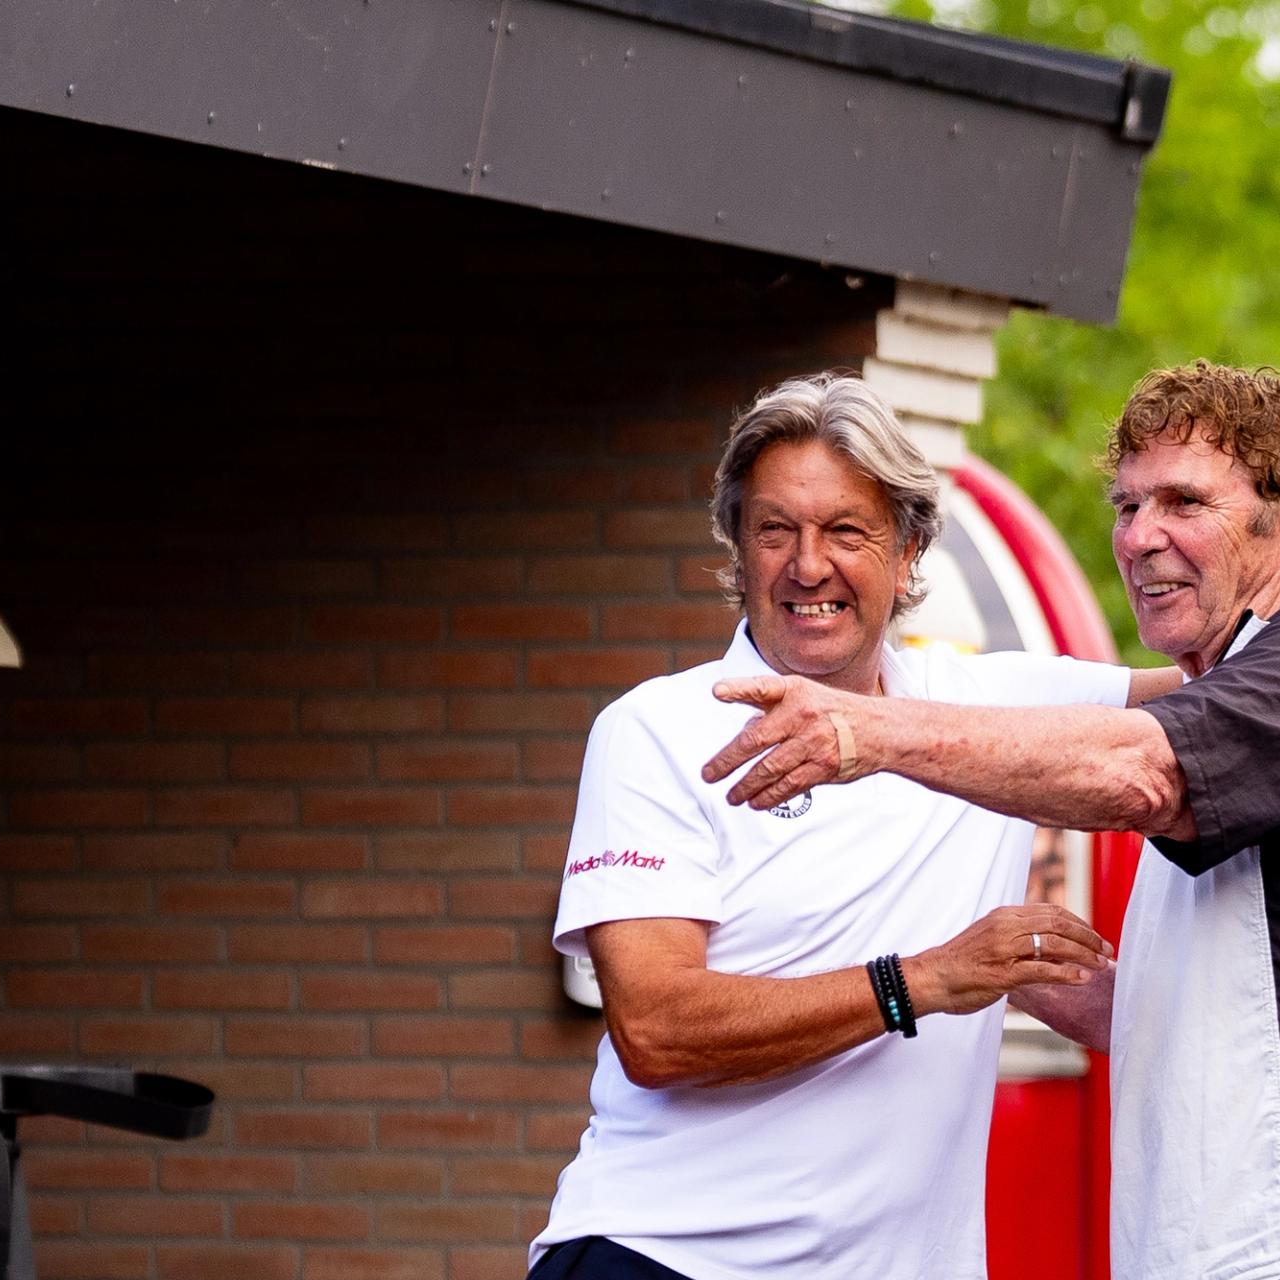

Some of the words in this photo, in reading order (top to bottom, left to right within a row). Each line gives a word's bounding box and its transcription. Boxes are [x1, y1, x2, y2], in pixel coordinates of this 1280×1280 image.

[769, 797, 812, 818] OTTERDAM
[563, 857, 600, 880] Media
[613, 850, 665, 871] Markt
